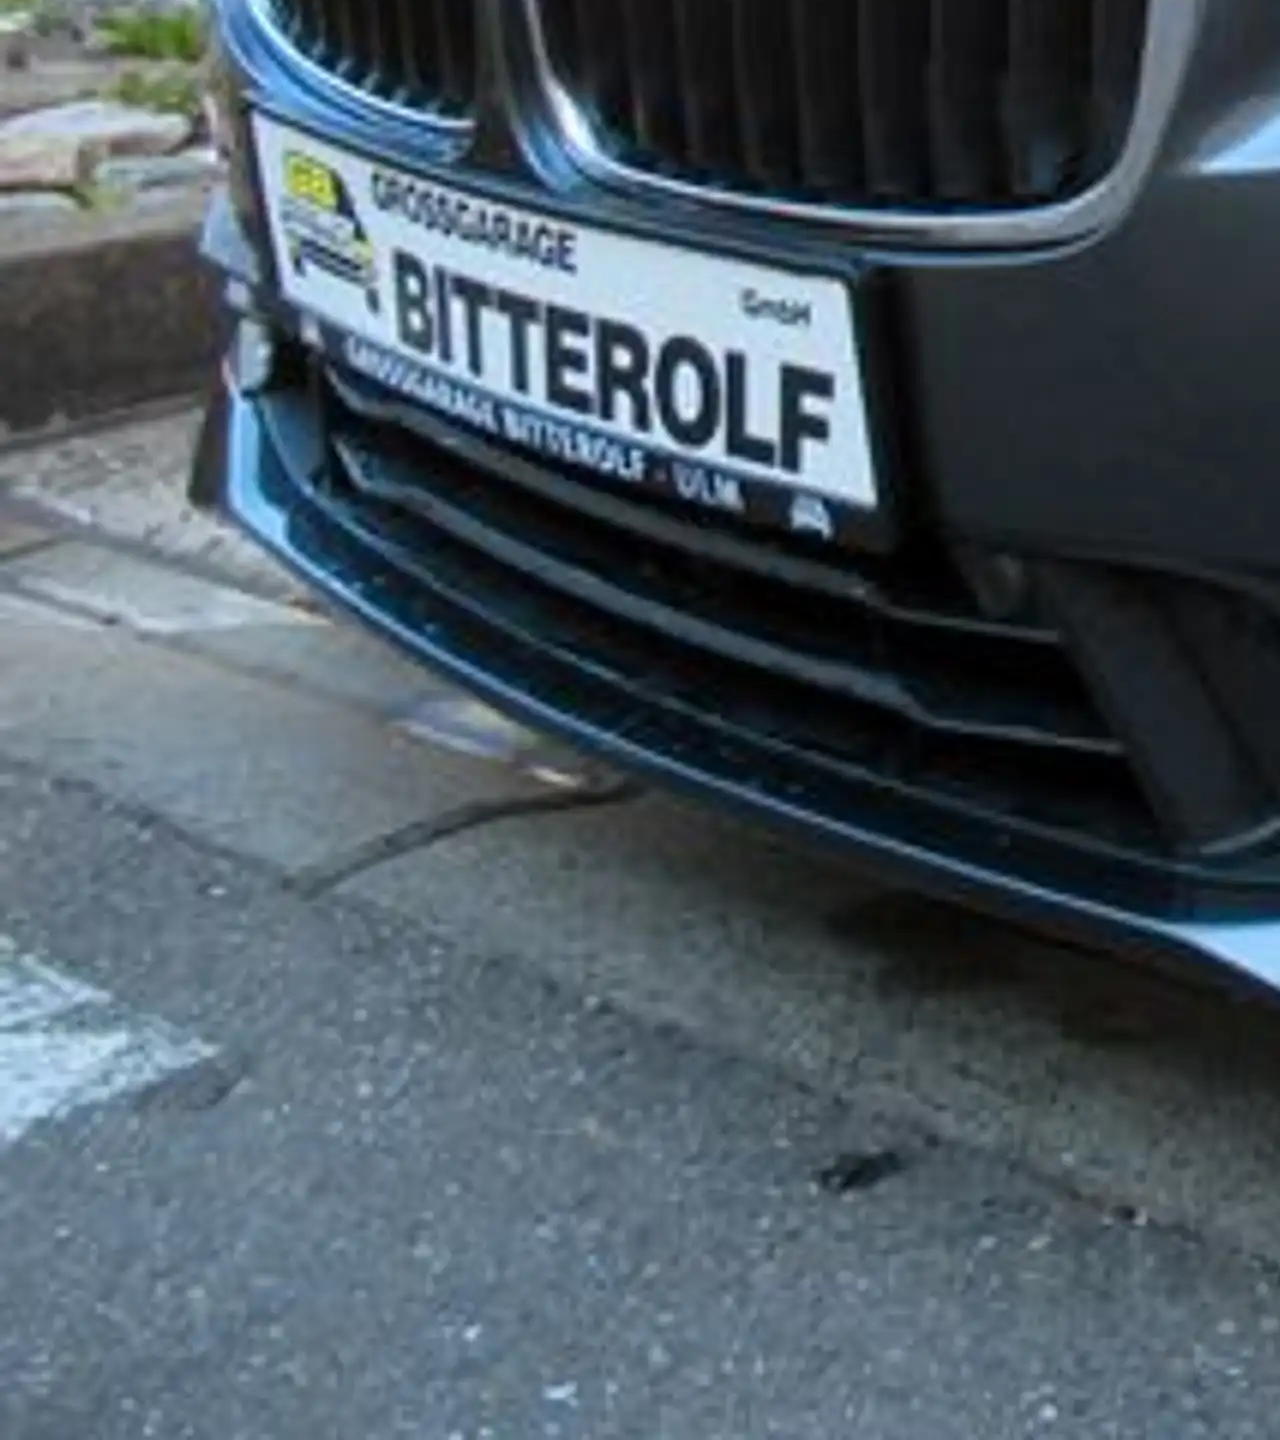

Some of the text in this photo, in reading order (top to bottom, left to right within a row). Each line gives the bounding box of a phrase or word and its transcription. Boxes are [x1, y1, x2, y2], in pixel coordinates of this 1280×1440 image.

[371, 168, 578, 277] GROSSGARAGE
[741, 287, 812, 328] GmbH
[393, 251, 836, 474] BITTEROLF
[503, 406, 644, 482] BITTEROLF
